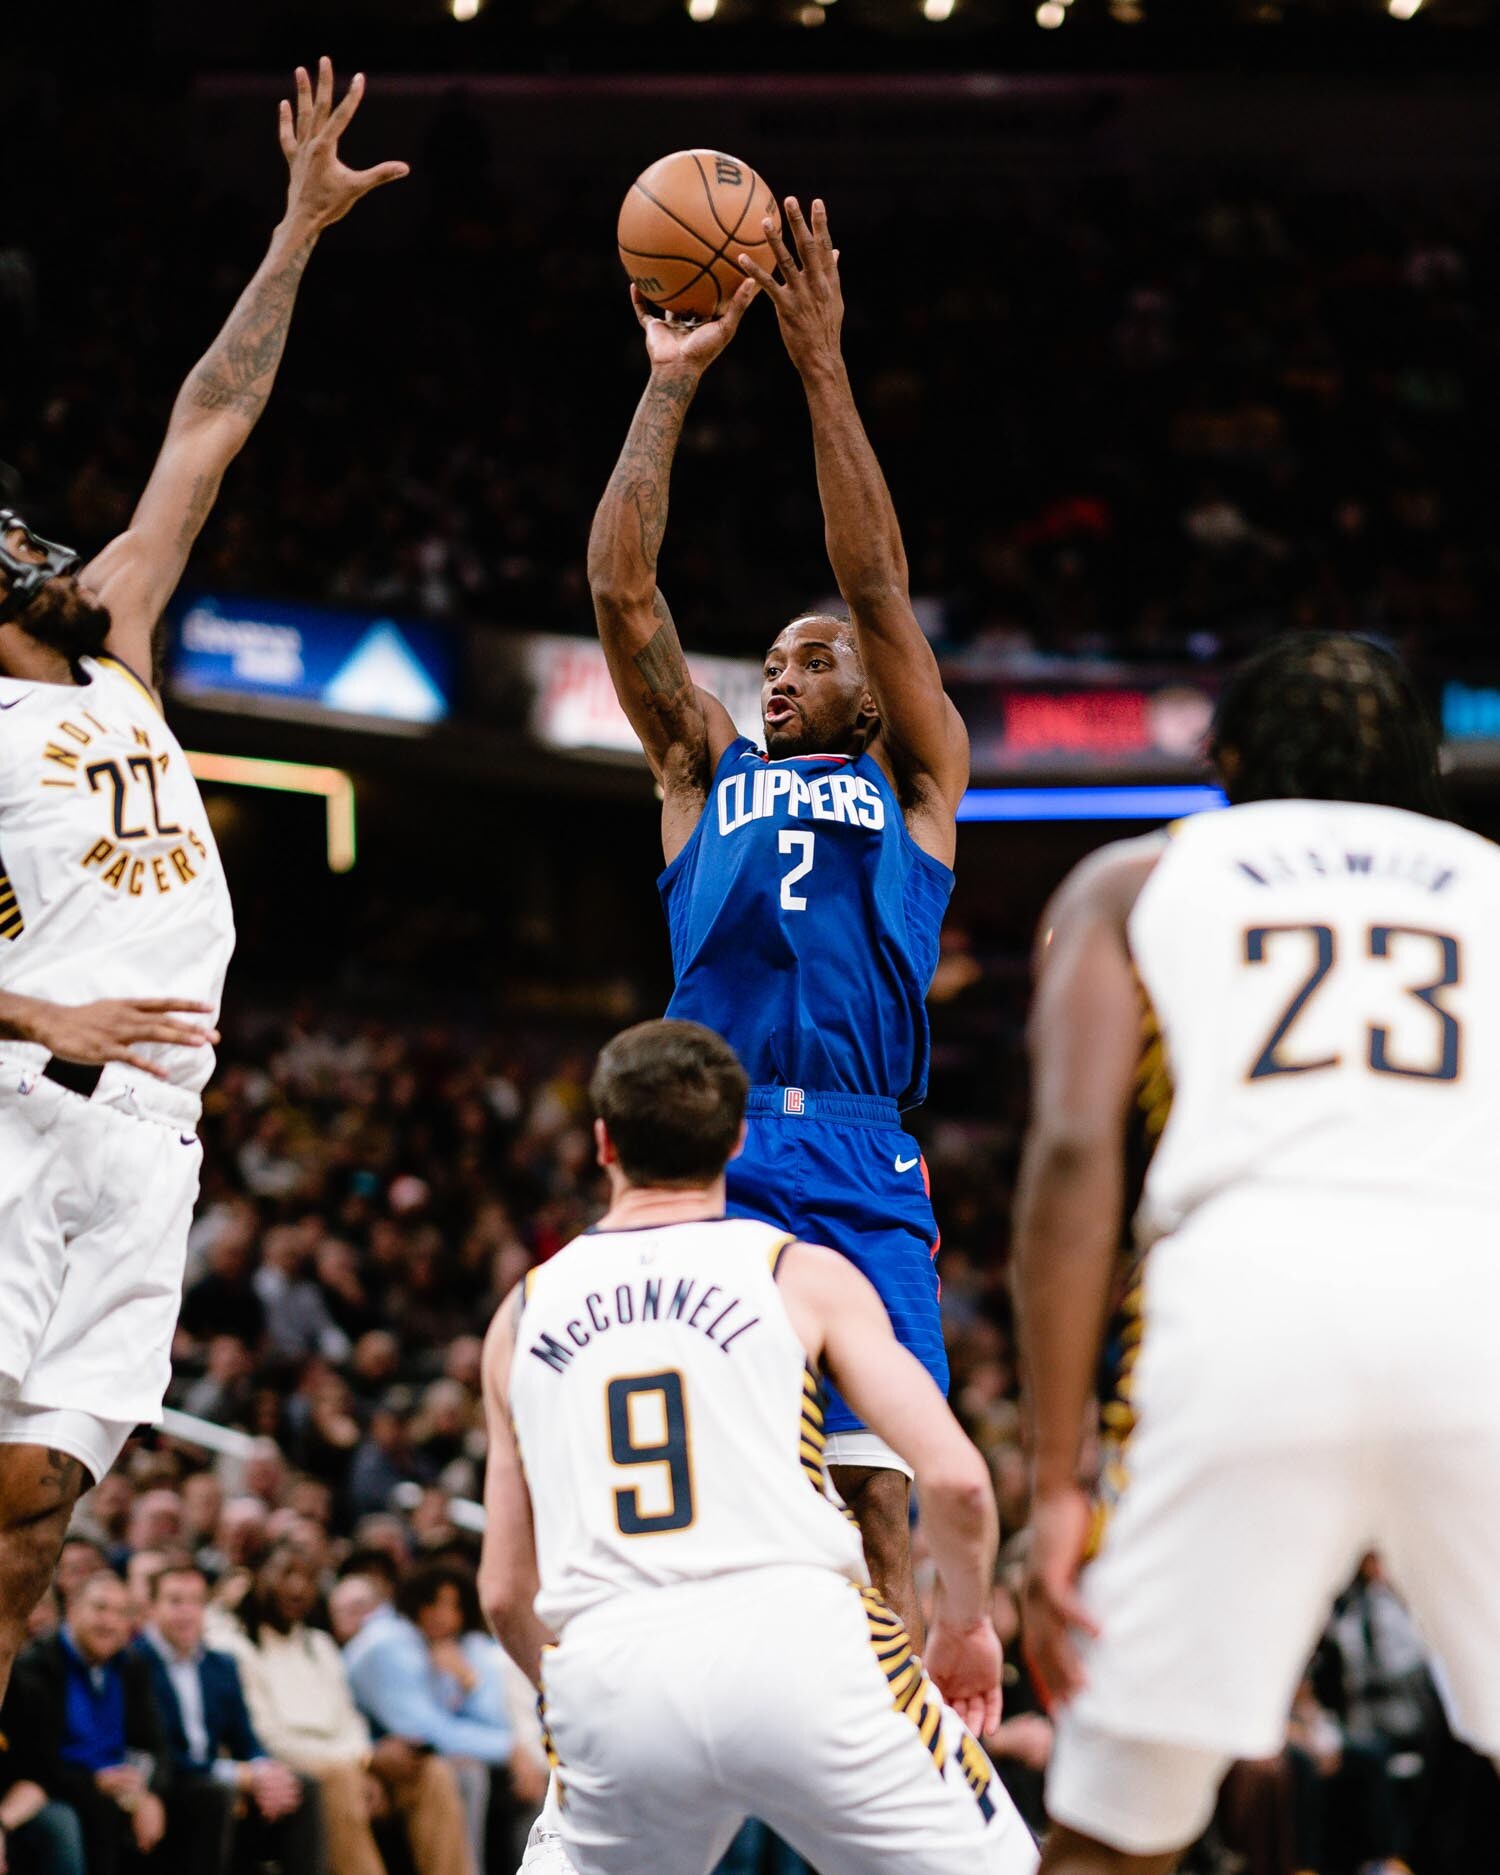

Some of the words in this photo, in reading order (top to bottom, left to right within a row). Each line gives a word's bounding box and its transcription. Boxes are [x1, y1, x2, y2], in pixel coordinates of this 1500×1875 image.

[85, 756, 183, 839] 22
[717, 769, 885, 836] CLIPPERS
[80, 829, 207, 896] PACERS
[778, 830, 815, 911] 2
[1240, 922, 1462, 1083] 23
[529, 1278, 760, 1375] McCONNELL
[606, 1368, 696, 1536] 9
